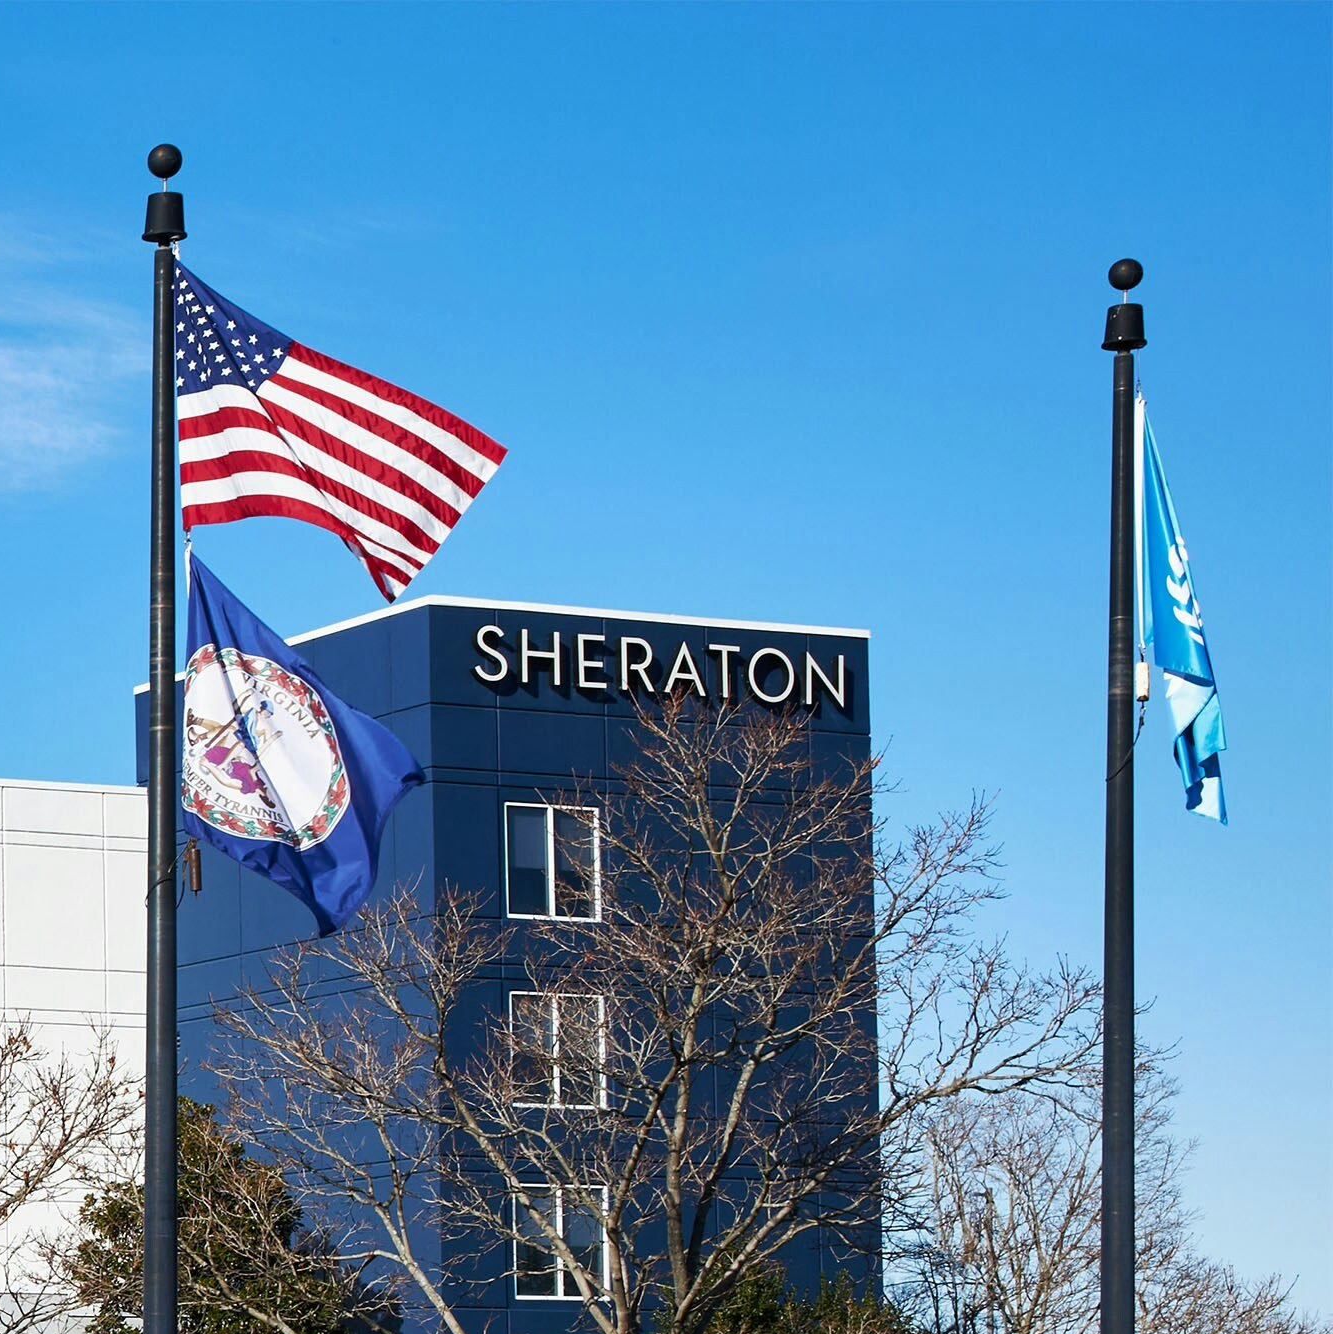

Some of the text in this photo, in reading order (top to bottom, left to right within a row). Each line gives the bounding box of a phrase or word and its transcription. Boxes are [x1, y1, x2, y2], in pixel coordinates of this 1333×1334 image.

[473, 624, 845, 708] SHERATON
[242, 672, 321, 739] VIRGINIA
[214, 792, 284, 822] TYRANNIS
